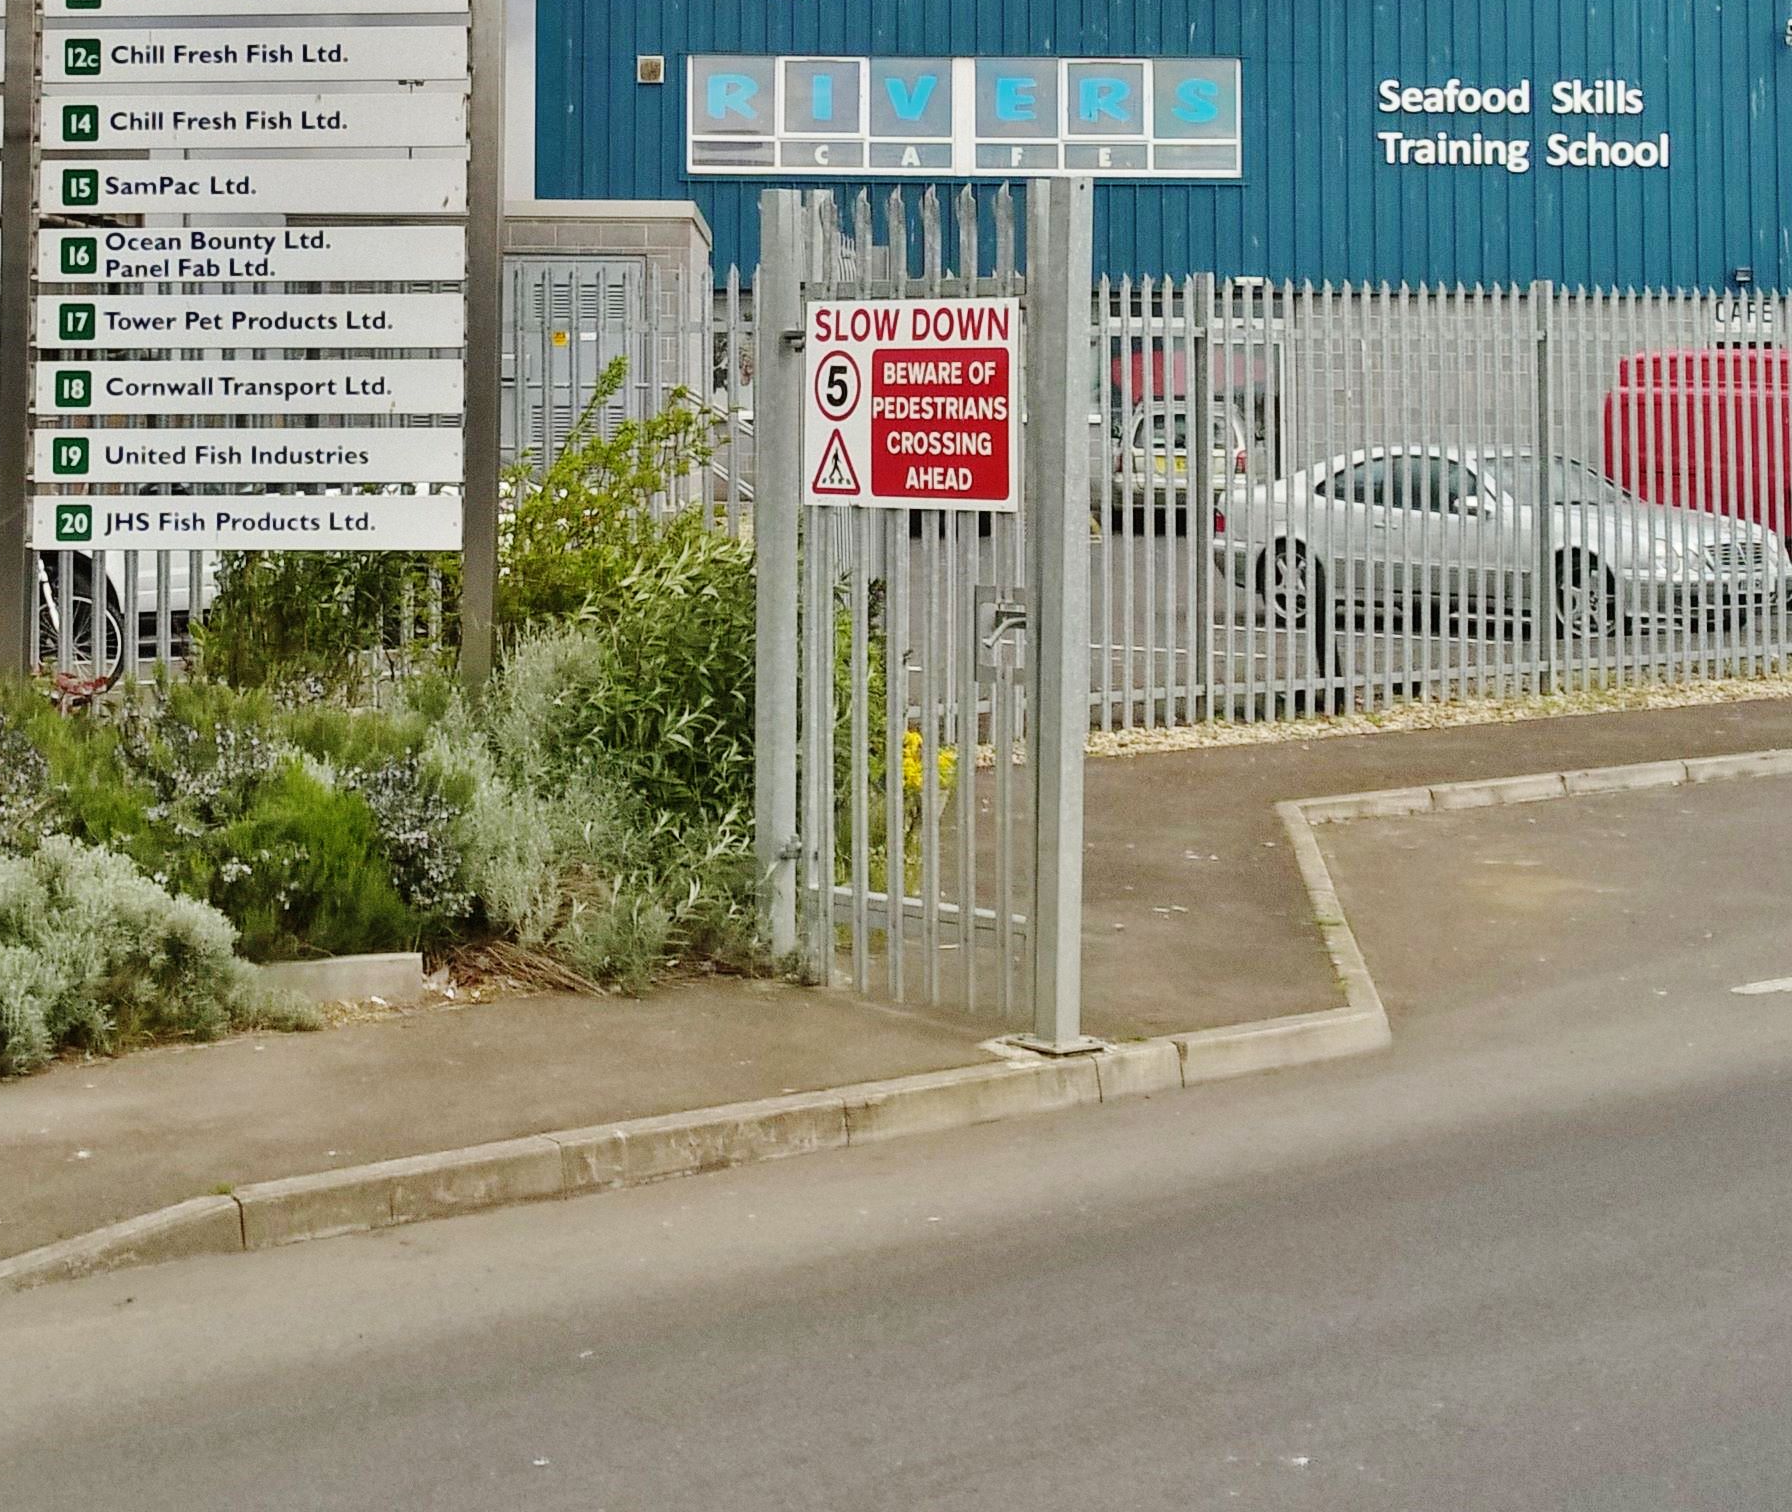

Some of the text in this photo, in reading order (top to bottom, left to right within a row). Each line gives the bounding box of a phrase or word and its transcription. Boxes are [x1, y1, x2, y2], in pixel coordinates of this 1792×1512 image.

[111, 46, 164, 64] Chill
[174, 45, 237, 64] Fresh
[247, 45, 292, 63] Fish
[302, 45, 348, 62] Ltd.
[707, 74, 1218, 123] RIVERS
[1378, 78, 1643, 114] Seafood Skills
[70, 111, 347, 133] 14 Chill Fresh Fish Ltd.
[815, 145, 1111, 167] CAFE
[1378, 132, 1669, 172] Training School
[70, 176, 256, 198] 15 SamPac Ltd.
[69, 231, 331, 266] 16 Ocean Bounty Ltd.
[106, 259, 275, 277] Panel Fab Ltd.
[67, 311, 393, 332] 17 Tower Pet Products Ltd.
[816, 307, 1008, 342] SLOW DOWN
[883, 361, 995, 384] BEWARE OF
[63, 377, 391, 401] 18 Cornwall Transport Ltd.
[827, 366, 847, 406] 5
[873, 397, 1007, 420] PEDESTRIANS
[887, 432, 992, 455] CROSSING
[61, 446, 369, 466] 19 United Fish Industries
[905, 467, 972, 490] AHEAD
[62, 512, 375, 535] 20 JHS Fish Products Ltd.
